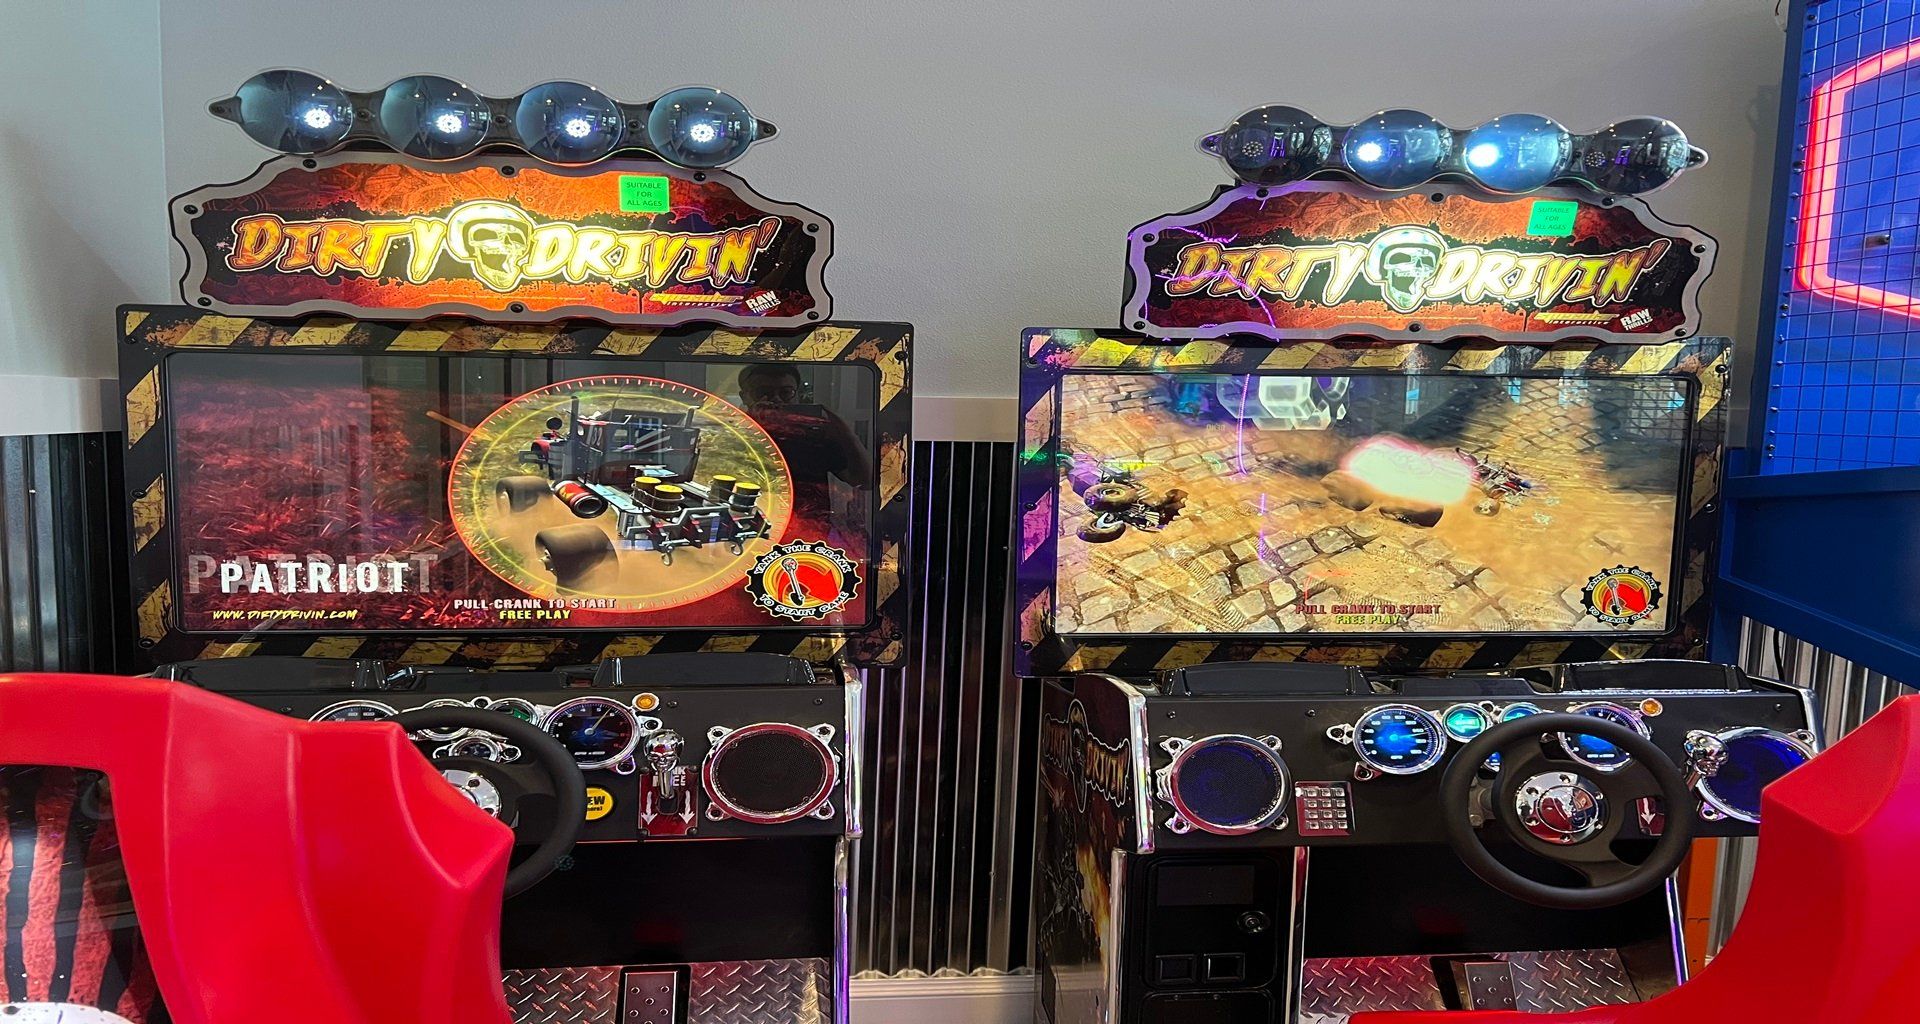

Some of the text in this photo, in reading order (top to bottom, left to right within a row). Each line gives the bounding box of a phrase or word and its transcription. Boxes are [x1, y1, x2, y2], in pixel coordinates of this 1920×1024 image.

[626, 181, 662, 189] SUITABLE
[226, 213, 781, 288] DIRTY DRIVIN'
[1165, 238, 1671, 307] DIRTY DRIVIN'
[745, 291, 777, 309] RAW
[1620, 308, 1650, 325] RAW
[754, 544, 852, 575] YANK THE CRANK
[220, 562, 409, 594] PATRIOT
[454, 598, 616, 609] PULL CRANK TO START
[760, 592, 849, 616] TO START GAME
[1295, 604, 1441, 614] PULL CRANK TO START
[500, 610, 571, 620] FREE PLAY
[1335, 614, 1401, 625] FREE PLAY
